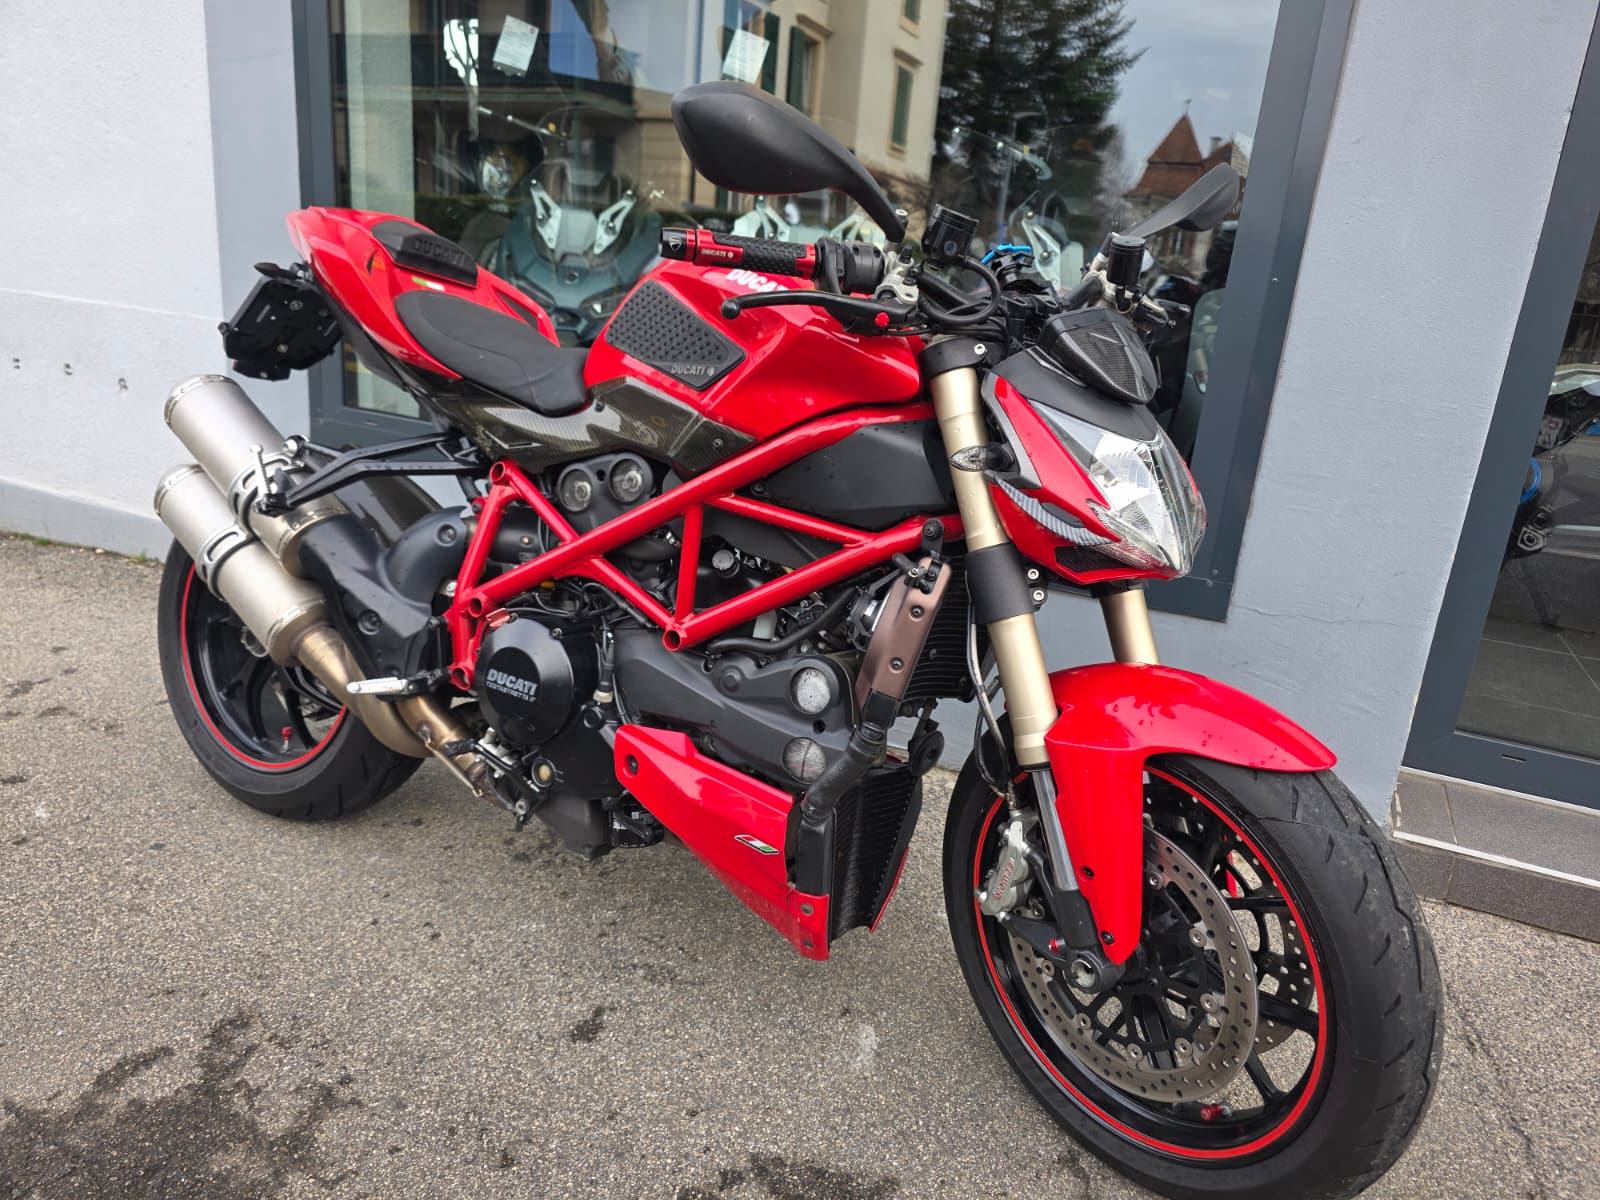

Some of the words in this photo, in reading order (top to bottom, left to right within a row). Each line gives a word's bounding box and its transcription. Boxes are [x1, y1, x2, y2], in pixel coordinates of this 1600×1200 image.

[413, 238, 466, 268] DUCATI
[701, 248, 727, 257] DUCATI
[671, 363, 706, 375] DUCATI
[487, 668, 538, 696] DUCATI
